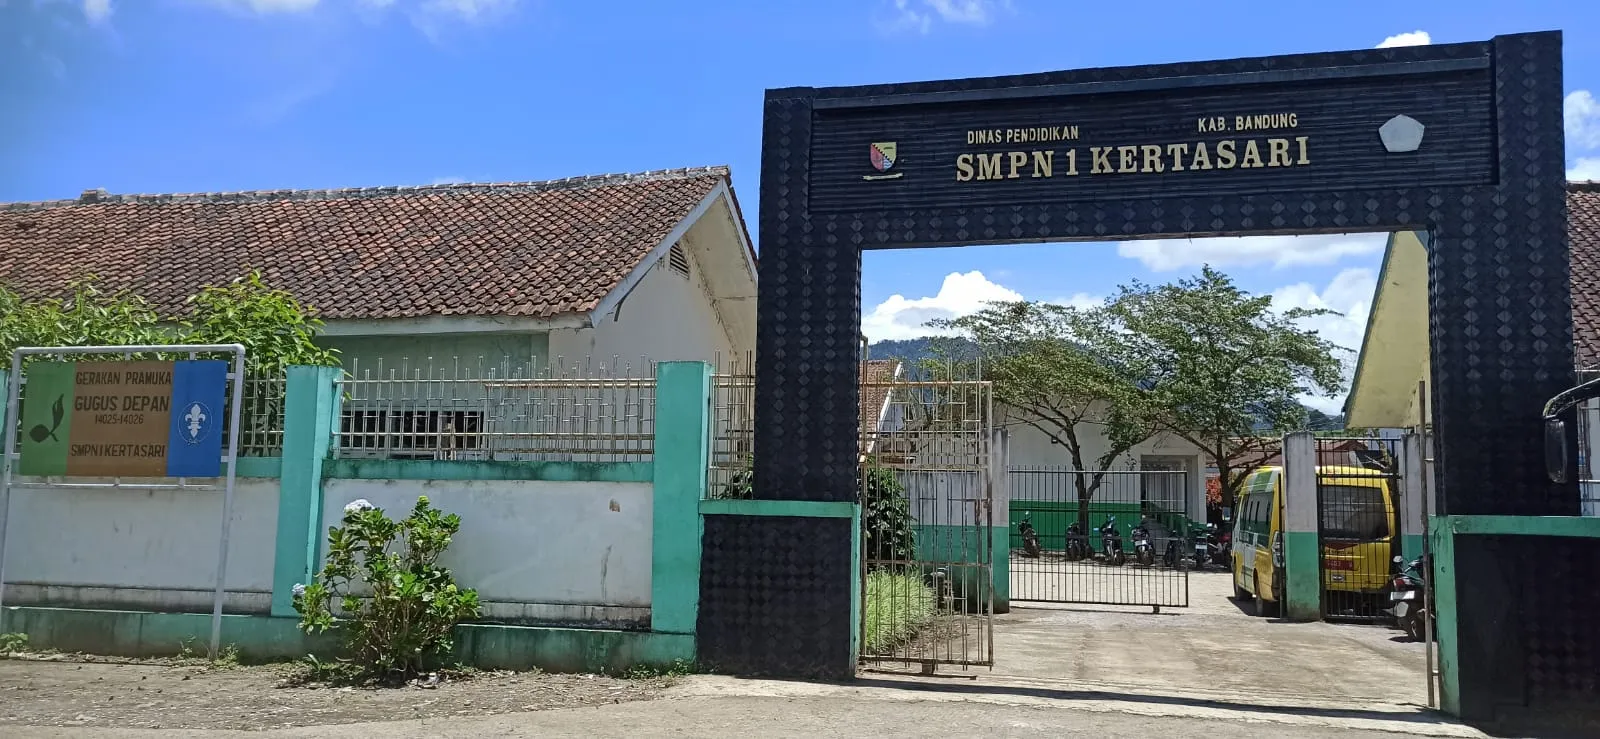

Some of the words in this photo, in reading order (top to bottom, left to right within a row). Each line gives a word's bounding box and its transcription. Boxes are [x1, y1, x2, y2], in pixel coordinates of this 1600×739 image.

[967, 129, 1002, 145] DINAS
[1006, 125, 1079, 143] PENDIDIKAN
[1198, 116, 1231, 132] KAB.
[1235, 112, 1298, 131] BANDUNG
[956, 150, 1055, 182] SMPN
[1066, 148, 1079, 176] 1
[1090, 136, 1311, 175] KERTASARI
[75, 371, 120, 385] GERAKAN
[125, 371, 172, 385] PRAMUKA
[74, 395, 118, 412] GUGUS
[122, 395, 170, 412] DEPAN
[95, 414, 144, 425] 14025-14026
